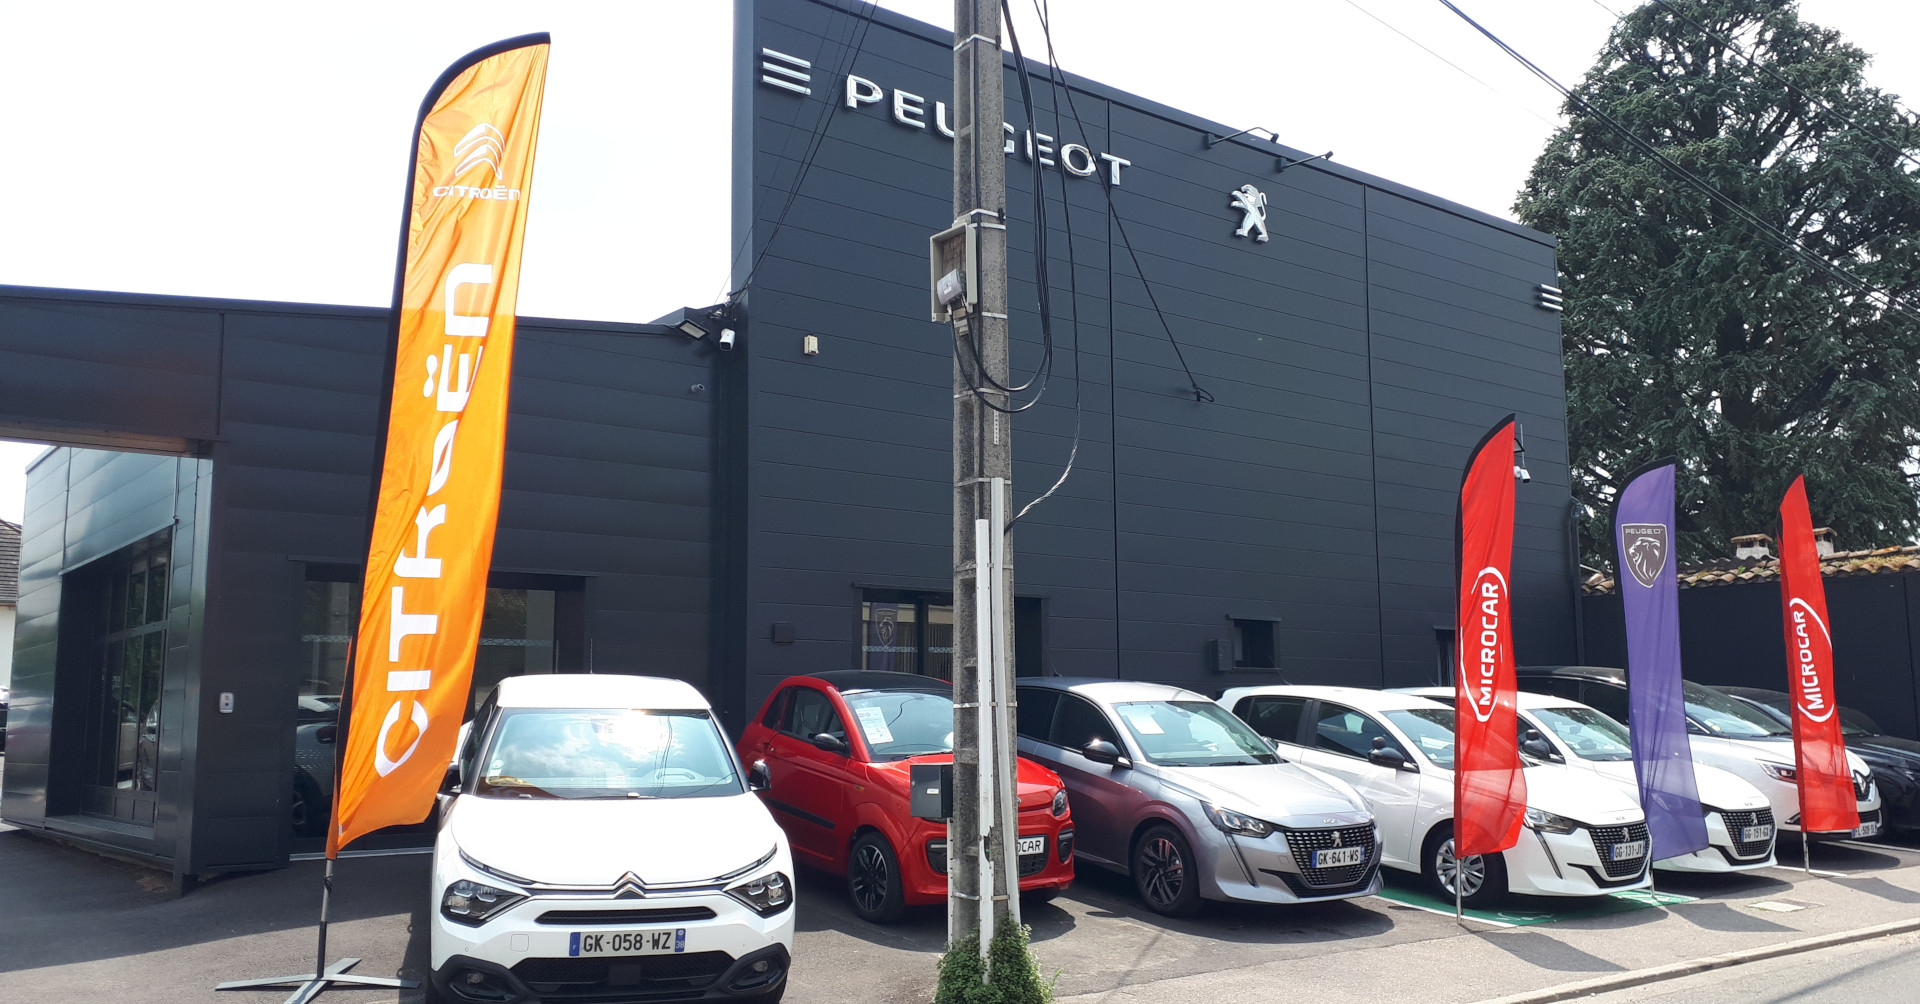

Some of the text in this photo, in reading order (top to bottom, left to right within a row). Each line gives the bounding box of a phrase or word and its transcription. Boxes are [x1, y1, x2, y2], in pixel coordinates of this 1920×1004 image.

[1479, 582, 1499, 706] MICROCAR
[1793, 610, 1825, 710] MICROCAR
[583, 932, 672, 953] GK-058-WZ
